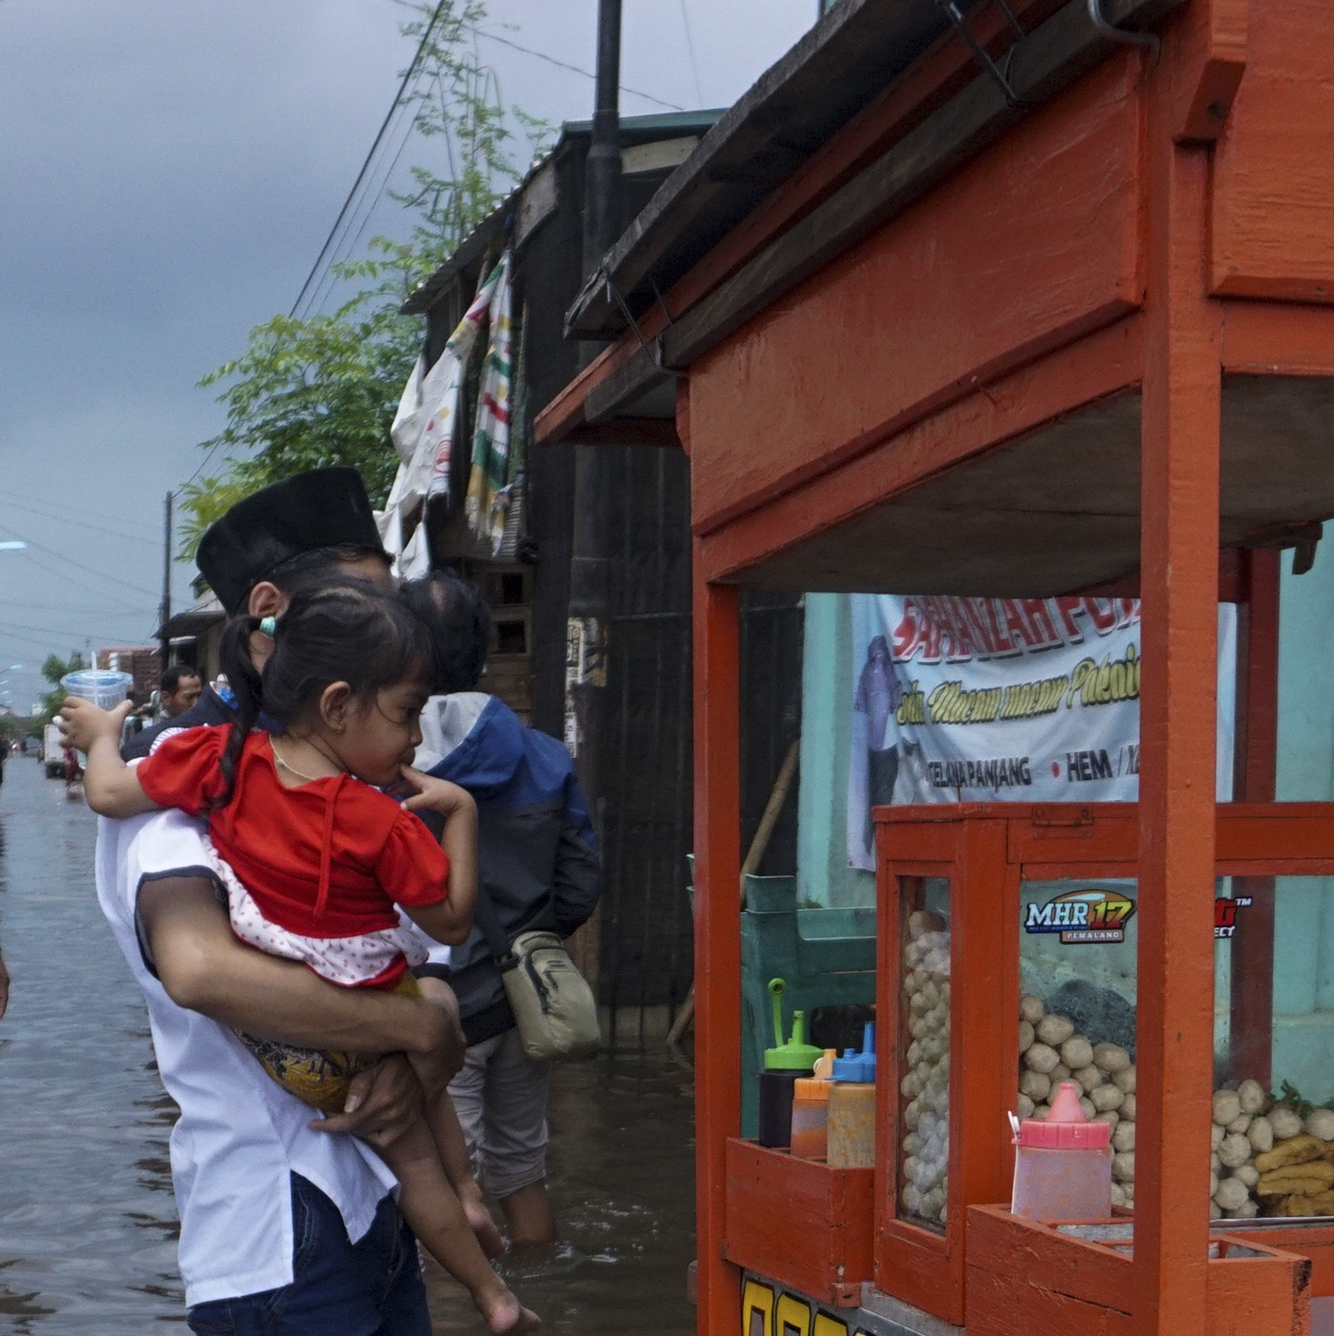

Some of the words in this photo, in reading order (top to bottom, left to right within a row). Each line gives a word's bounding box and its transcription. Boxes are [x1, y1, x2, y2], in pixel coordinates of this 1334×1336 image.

[966, 756, 1032, 794] PANJANG
[1066, 749, 1113, 782] HEM
[1026, 902, 1089, 927] MHR
[1090, 900, 1134, 929] 17
[1067, 931, 1120, 940] PEMALANG
